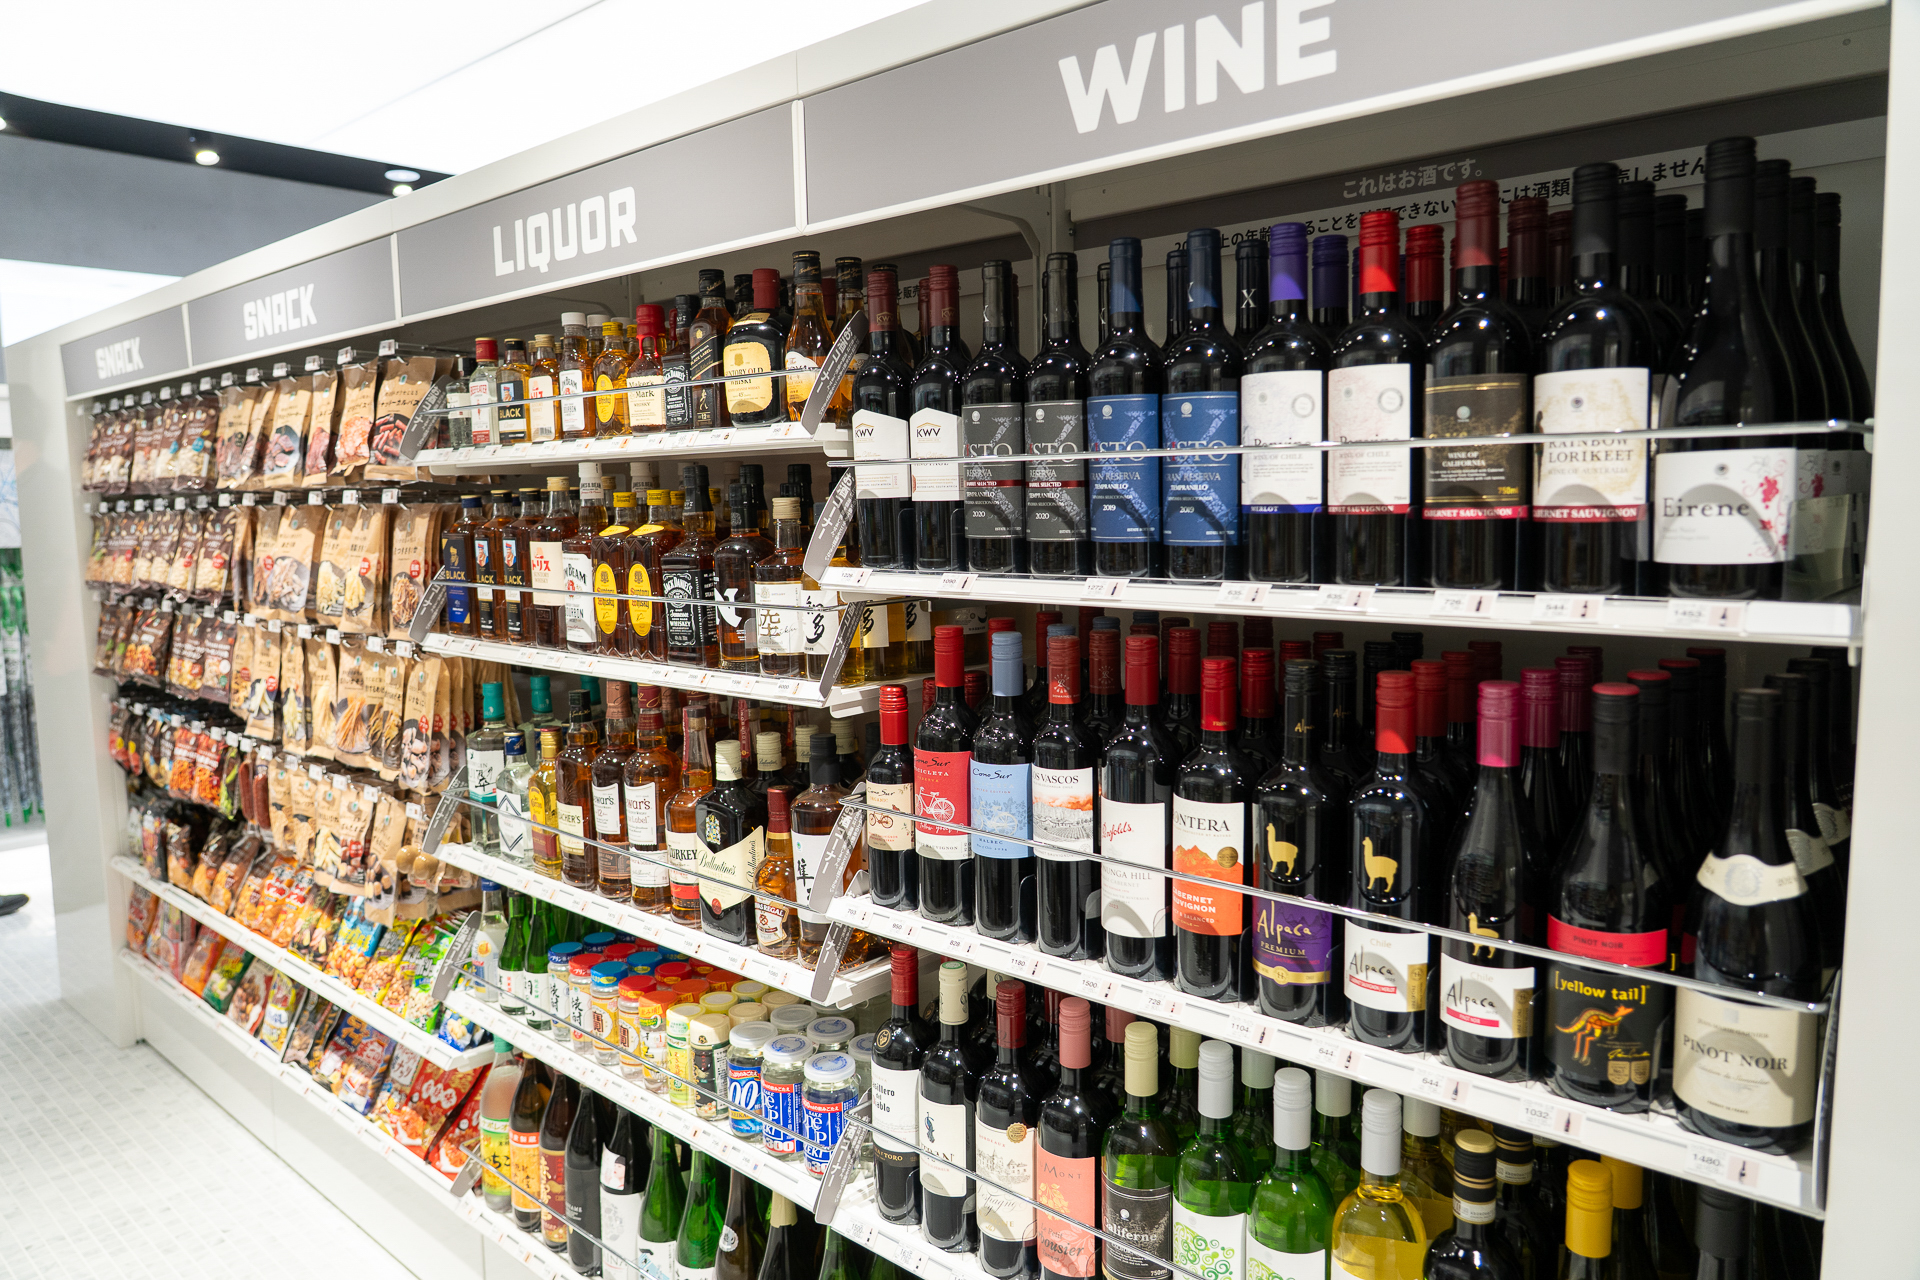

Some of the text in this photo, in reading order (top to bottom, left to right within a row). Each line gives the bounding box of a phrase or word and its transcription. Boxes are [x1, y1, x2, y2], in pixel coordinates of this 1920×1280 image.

[1058, 0, 1337, 134] WINE
[1342, 157, 1484, 199] これはお酒です。
[493, 186, 638, 277] LIQUOR
[242, 283, 318, 341] SNACK
[95, 337, 144, 380] SNACK
[635, 389, 655, 398] Mark
[500, 408, 521, 418] BLACK
[855, 428, 874, 438] KWV
[916, 427, 941, 438] KWV
[1447, 451, 1466, 459] WINE
[1548, 450, 1634, 463] LORIKEET
[1442, 459, 1486, 468] CALIFORNIA
[1105, 472, 1141, 480] RESERVA
[1183, 472, 1221, 481] RESERVA
[1497, 485, 1519, 495] 750ml
[817, 472, 855, 540] お酒コーナー
[1662, 497, 1750, 517] Eirene
[1459, 507, 1512, 518] SAUVIGNON
[1571, 507, 1637, 518] SAUVIGNON
[532, 560, 551, 572] トリス
[446, 570, 466, 580] BLACK
[663, 580, 675, 594] JACK
[566, 607, 584, 618] OURBON
[670, 620, 691, 628] WHISKEY
[926, 756, 951, 768] Sur
[972, 768, 1013, 780] Cono Sur
[1044, 773, 1079, 785] VASCOS
[632, 816, 648, 824] Label
[1174, 809, 1230, 832] ONTERA
[978, 837, 1003, 845] MALBEC
[668, 845, 698, 861] TURKEY
[697, 848, 737, 877] Ballantine's
[1131, 871, 1152, 880] HILL
[763, 903, 784, 917] REGAL
[1173, 897, 1216, 914] AUVIGNON
[1184, 913, 1215, 924] BALANCED
[1257, 900, 1312, 944] Alpaca
[1369, 938, 1392, 949] Chile
[1573, 935, 1624, 949] PINOT NOIR
[1260, 941, 1306, 956] PREMIUM
[1349, 944, 1394, 980] Alpaca
[1470, 971, 1494, 982] Chile
[1555, 971, 1608, 999] [yellow
[1446, 976, 1496, 1013] Alpaca
[1148, 997, 1161, 1006] 728
[1231, 1023, 1249, 1033] 1104
[1318, 1047, 1334, 1057] 644
[1683, 1034, 1788, 1070] PINOT NOIR
[1422, 1076, 1439, 1087] 644
[1524, 1107, 1549, 1119] 1032
[978, 1133, 1006, 1148] BORDEAUX
[884, 1152, 903, 1162] TORO
[1692, 1153, 1721, 1167] 1480
[1047, 1225, 1063, 1239] Petit
[1150, 1267, 1168, 1277] 750ml
